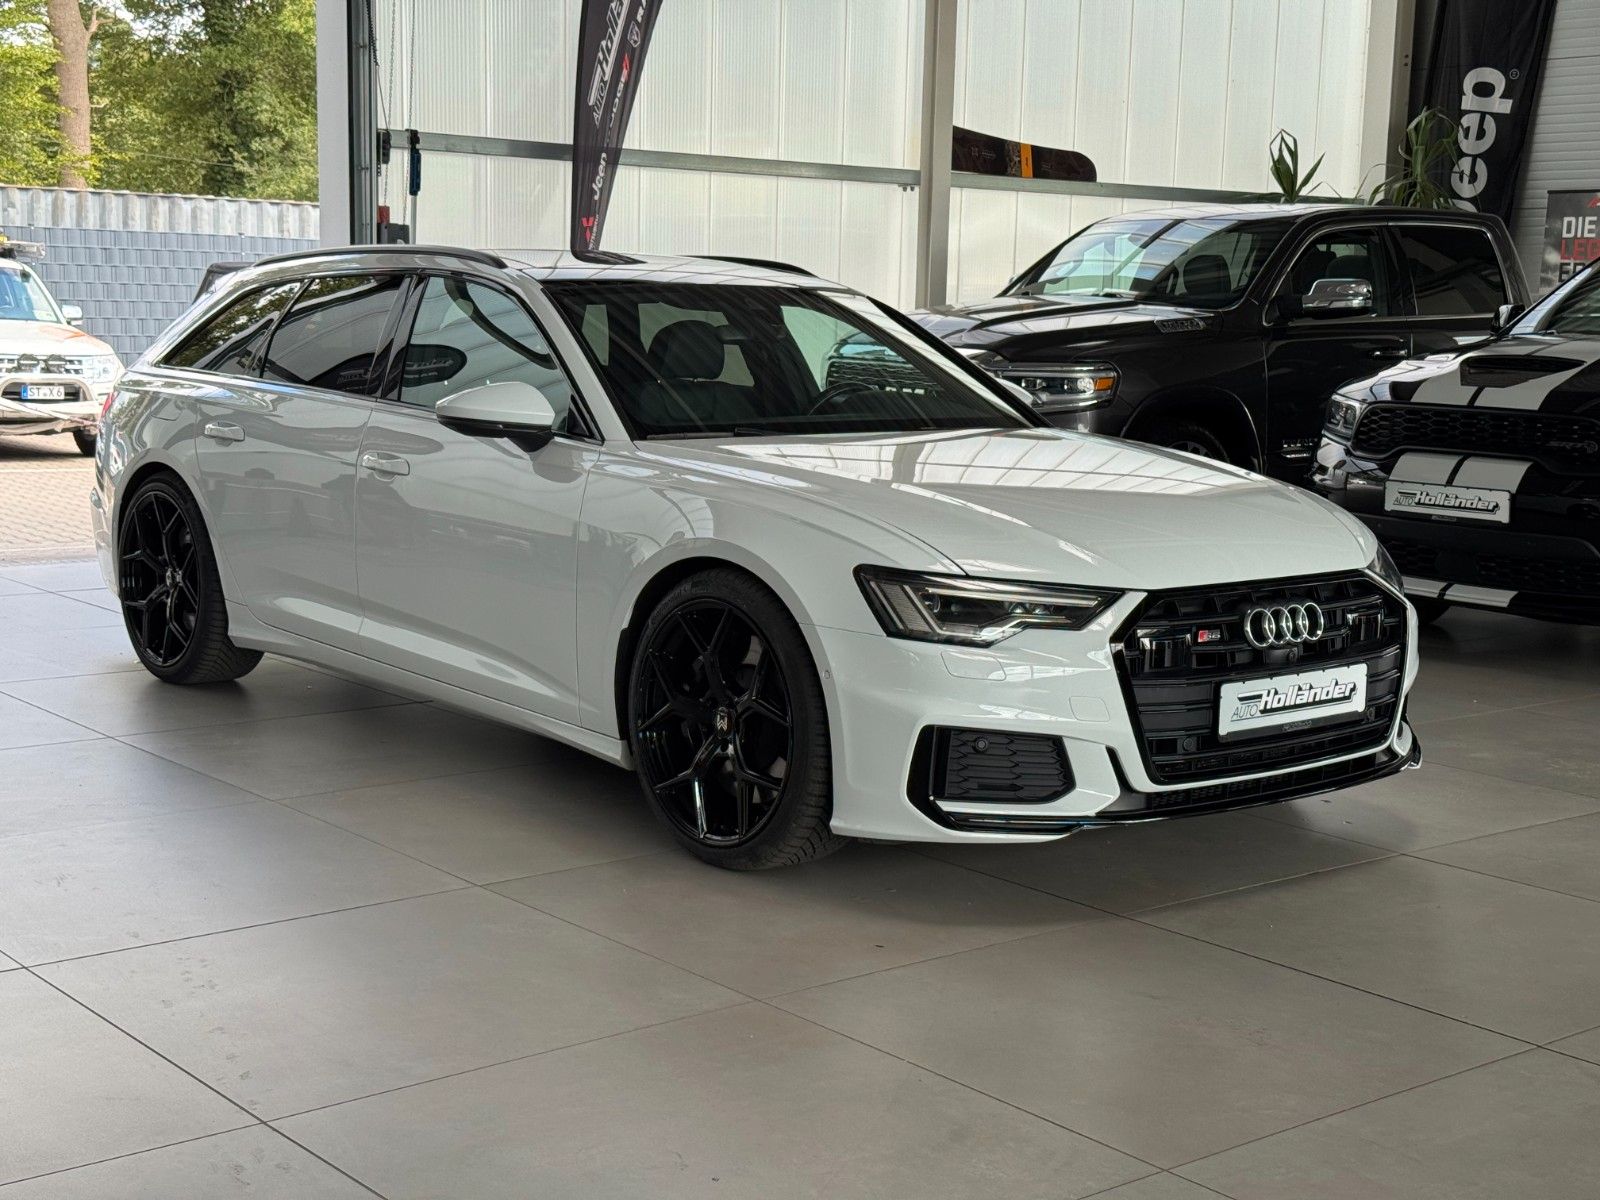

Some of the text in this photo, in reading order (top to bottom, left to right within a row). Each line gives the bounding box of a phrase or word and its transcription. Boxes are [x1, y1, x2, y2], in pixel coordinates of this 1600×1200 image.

[1450, 67, 1513, 213] eep
[1562, 216, 1597, 238] DIE
[29, 387, 41, 397] ST
[1393, 490, 1500, 513] AUTO Holländer
[1231, 678, 1358, 720] AUTO Holländer
